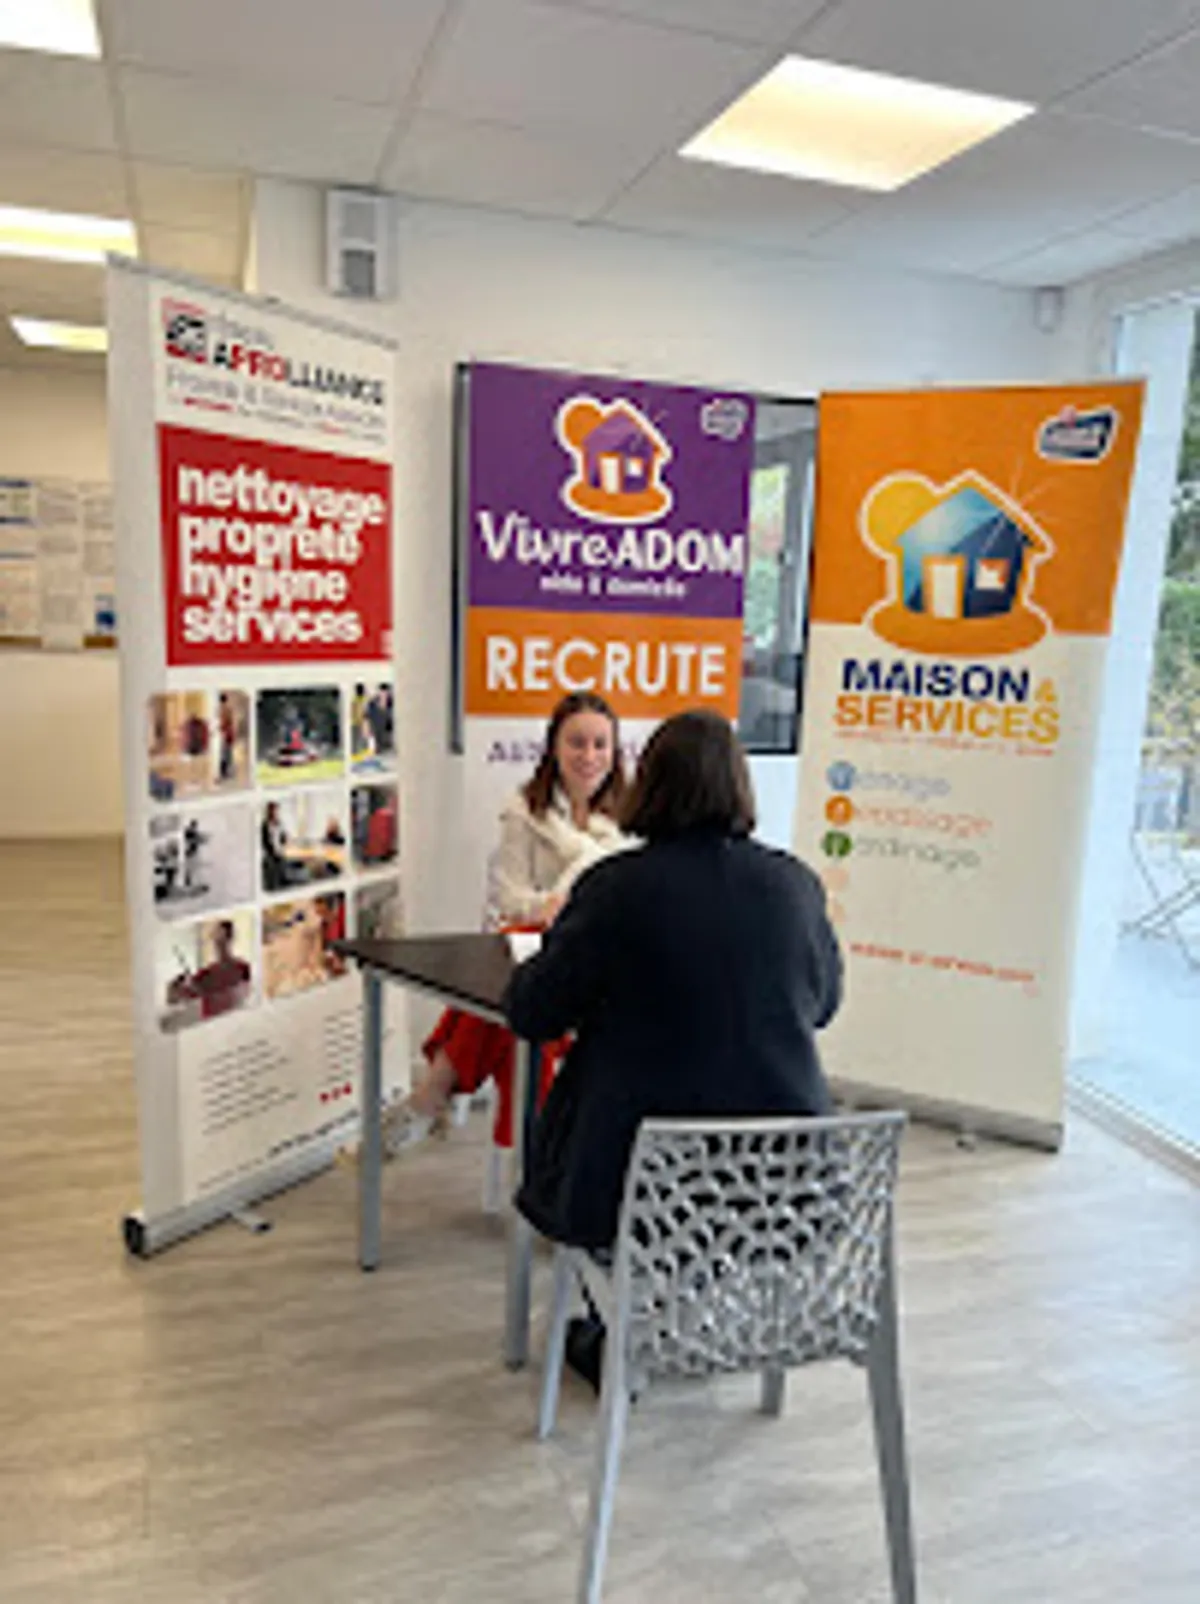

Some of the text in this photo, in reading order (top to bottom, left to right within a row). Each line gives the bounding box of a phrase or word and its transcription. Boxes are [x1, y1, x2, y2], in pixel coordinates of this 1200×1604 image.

[177, 464, 385, 530] nettoyage
[182, 604, 363, 644] services
[484, 634, 727, 697] RECRUTE
[841, 658, 1031, 703] MAISON
[832, 693, 1061, 745] SERVICES
